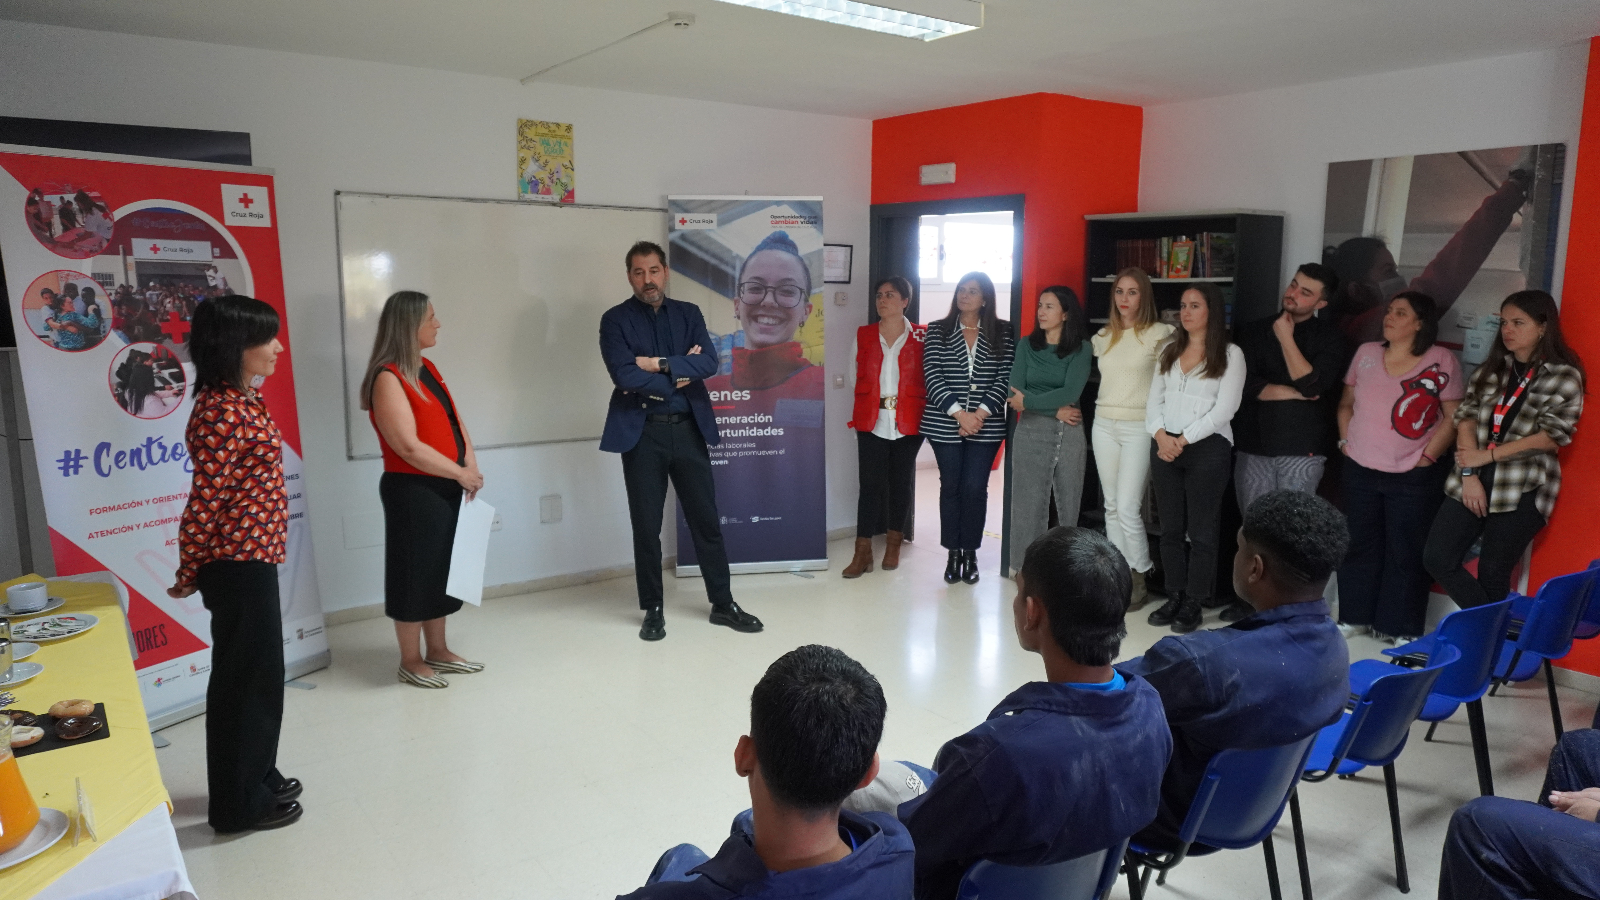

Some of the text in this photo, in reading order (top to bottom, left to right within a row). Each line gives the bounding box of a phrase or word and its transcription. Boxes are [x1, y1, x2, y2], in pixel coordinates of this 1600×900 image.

[708, 389, 751, 402] enes
[738, 450, 778, 458] promueven
[89, 500, 143, 516] FORMACIÓN
[88, 524, 134, 540] ATENCIÓN
